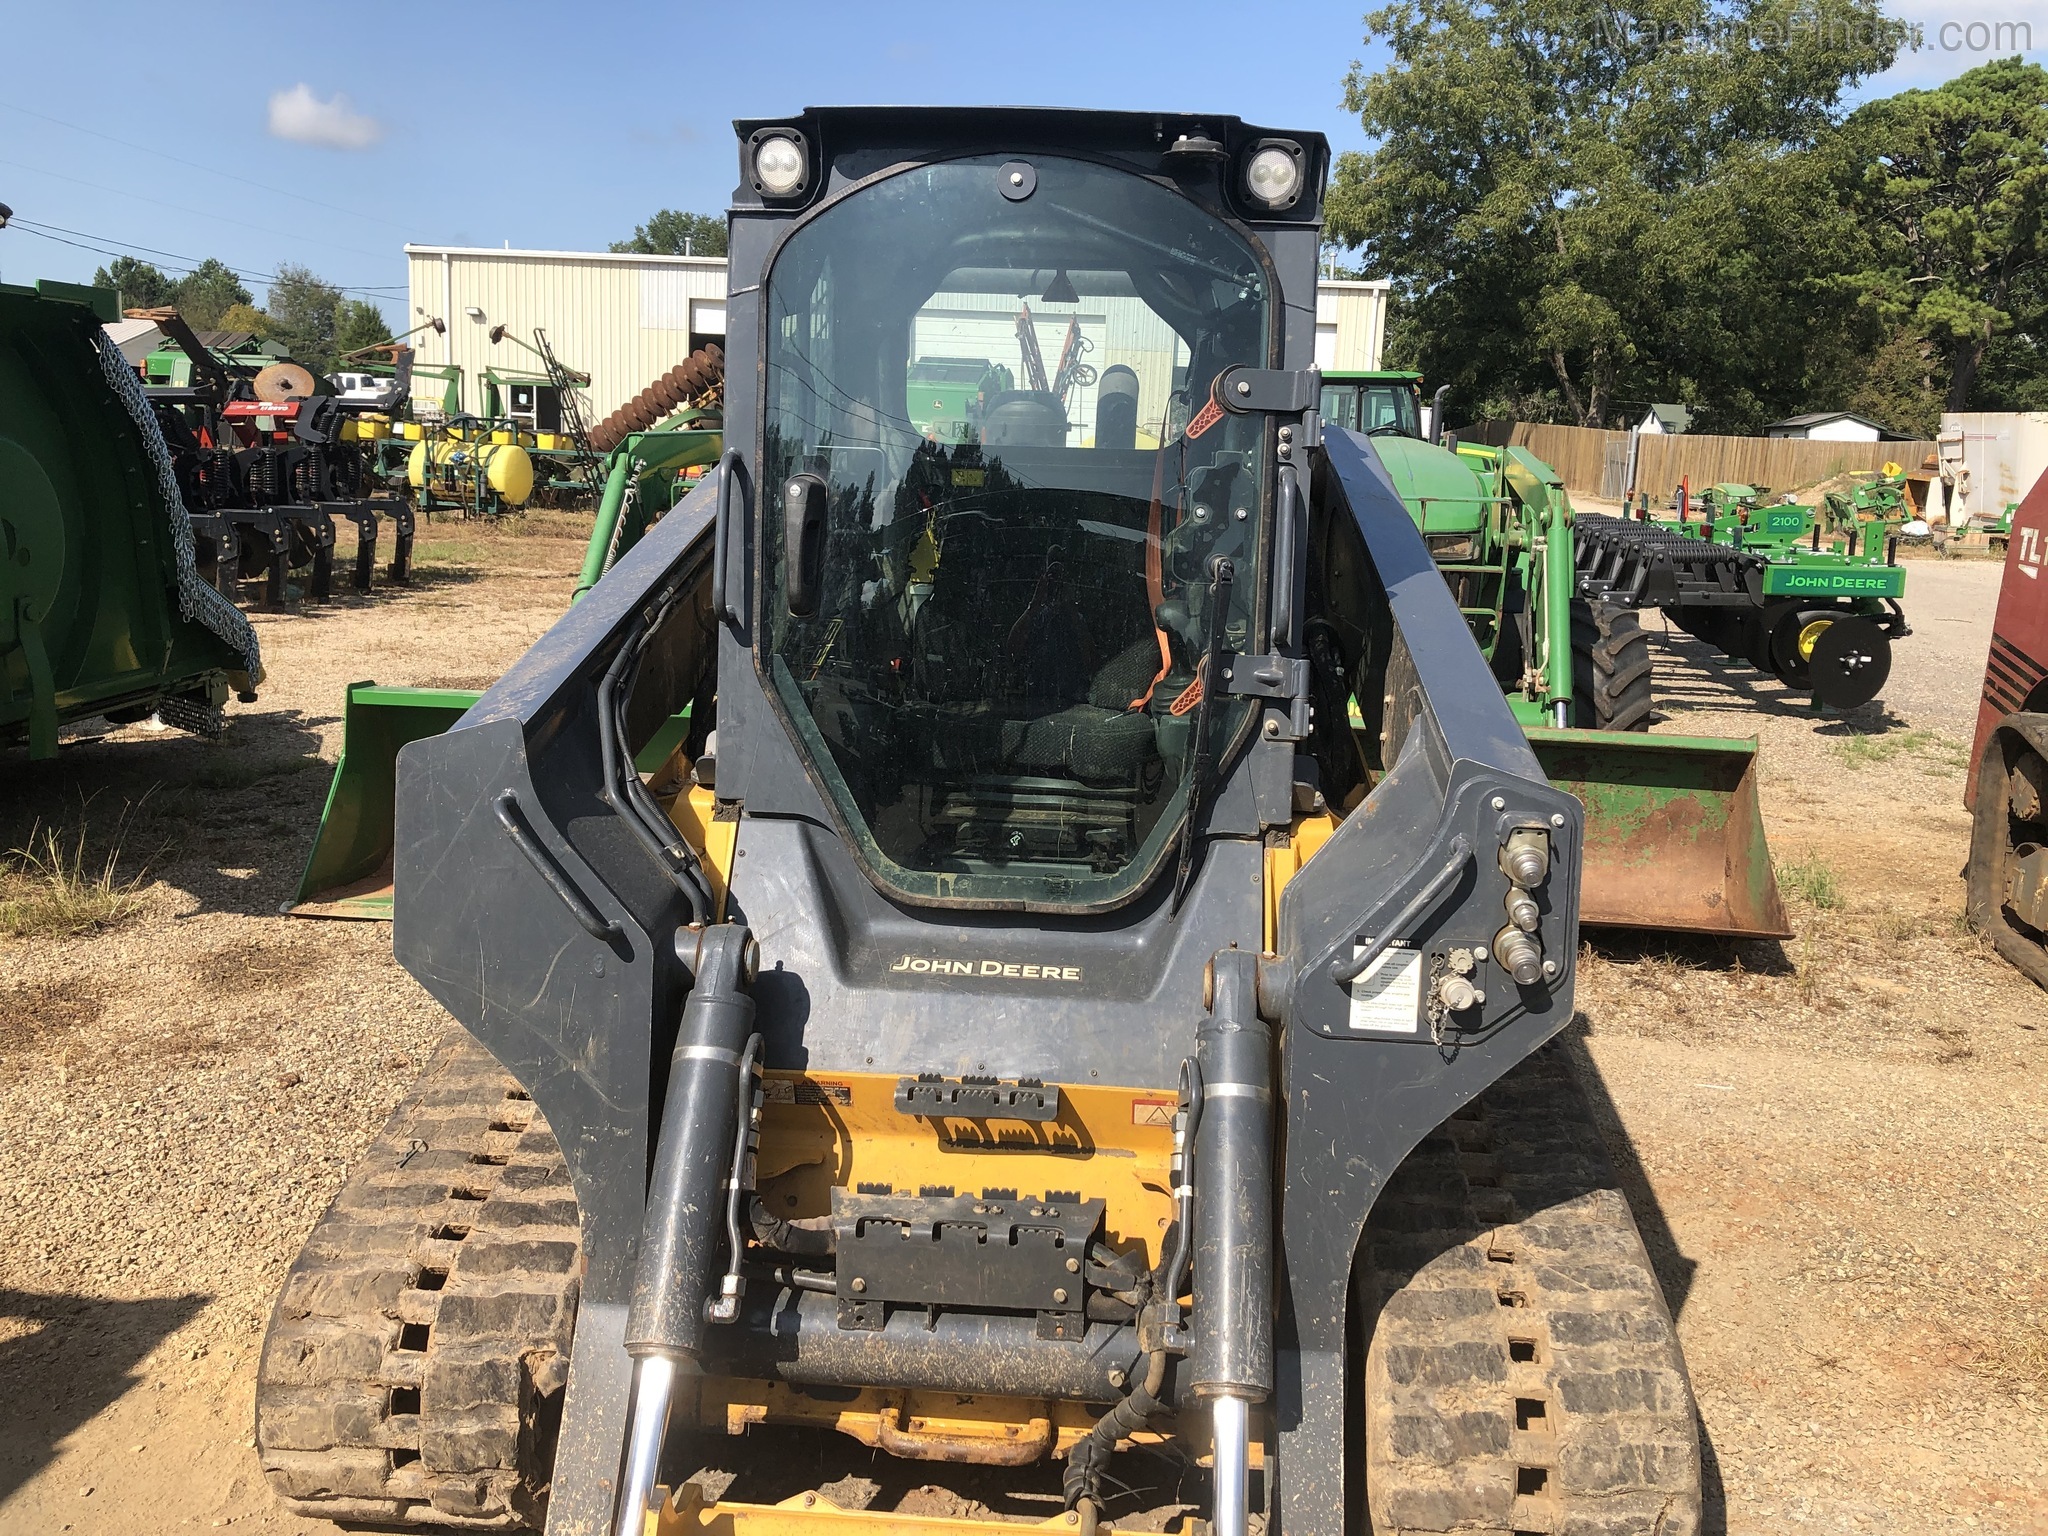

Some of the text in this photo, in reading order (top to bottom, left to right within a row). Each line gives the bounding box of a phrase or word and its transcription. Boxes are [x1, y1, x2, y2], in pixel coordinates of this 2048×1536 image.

[1772, 517, 1799, 526] 2100
[1785, 575, 1888, 589] JOHN DEERE
[892, 956, 1081, 981] JOHN DEERE
